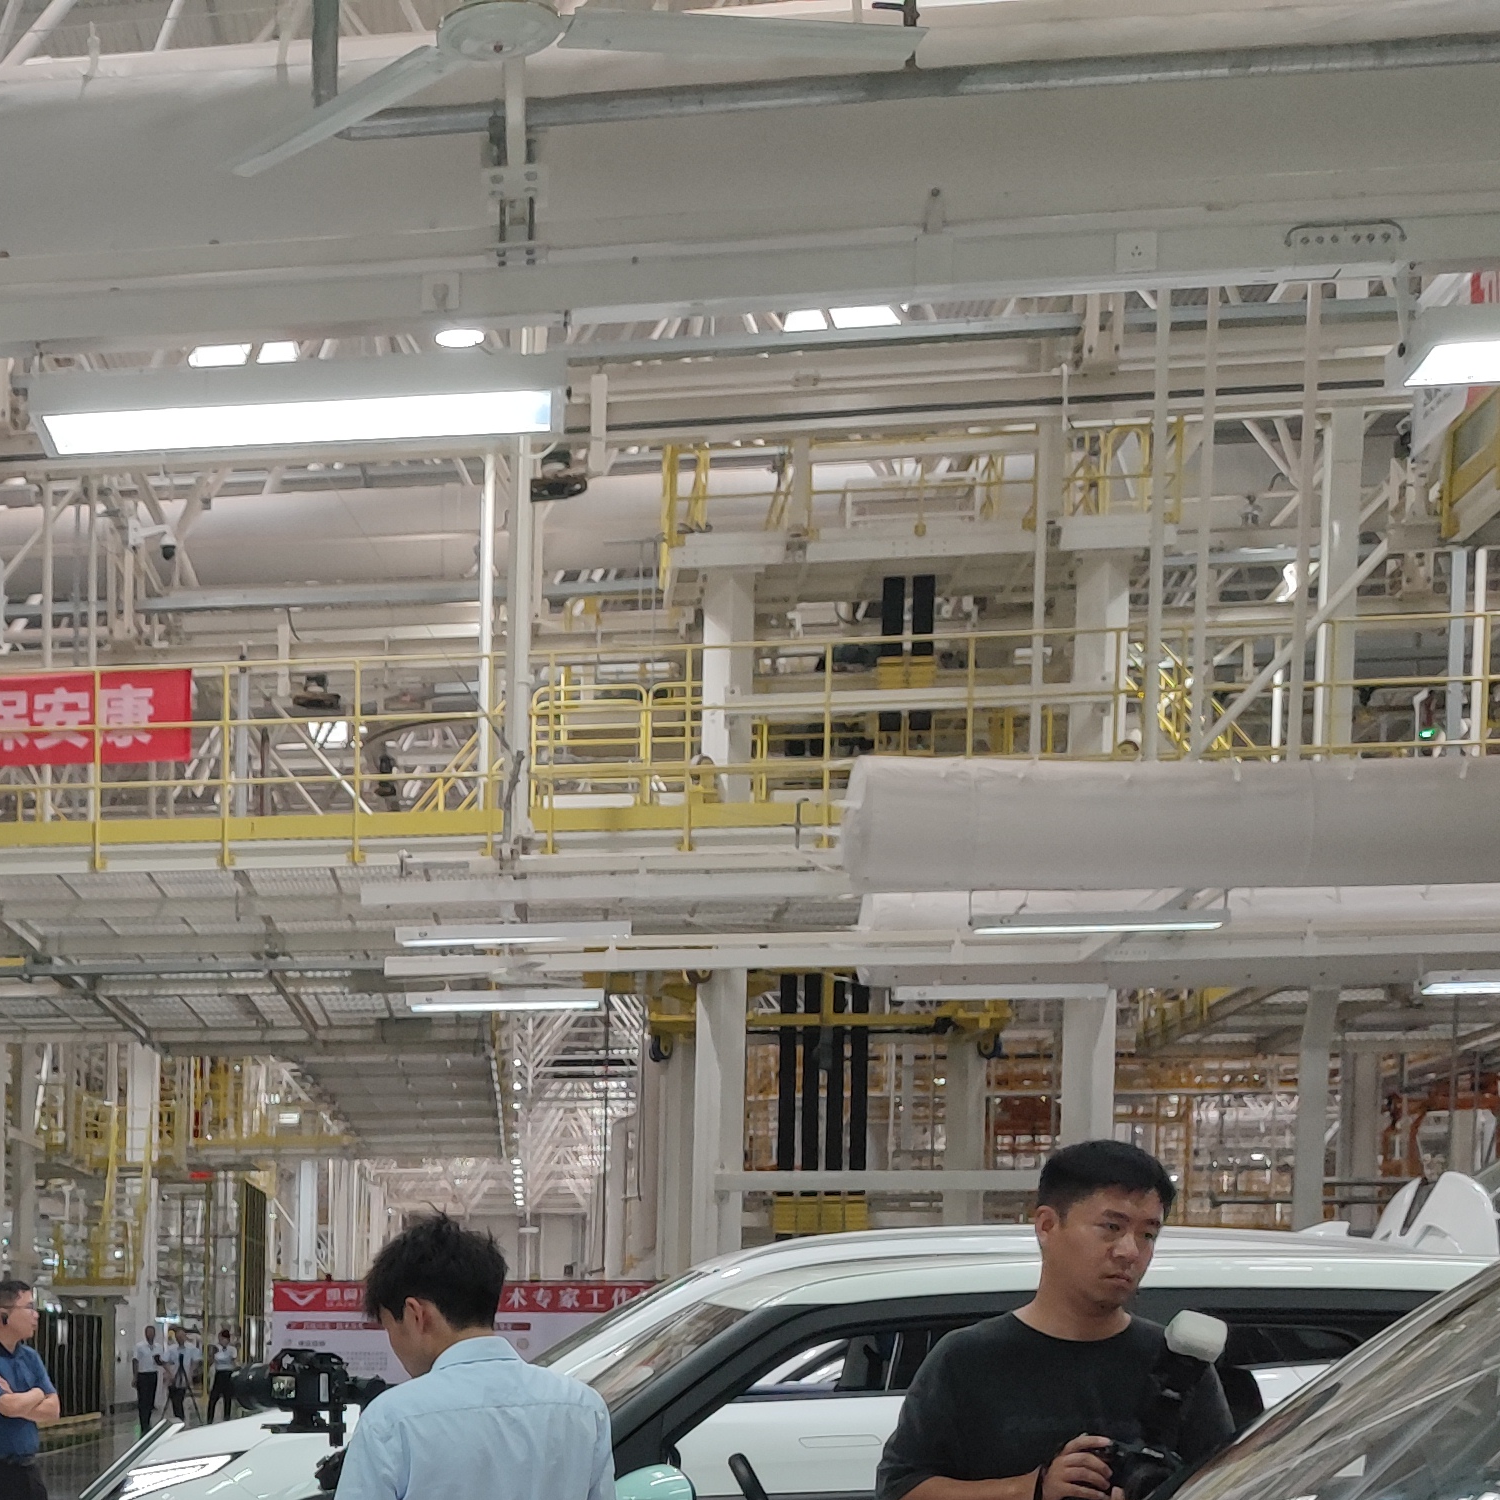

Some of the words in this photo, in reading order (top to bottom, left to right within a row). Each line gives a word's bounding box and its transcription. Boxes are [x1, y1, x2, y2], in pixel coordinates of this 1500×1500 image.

[505, 1286, 648, 1309] 术专家工作
